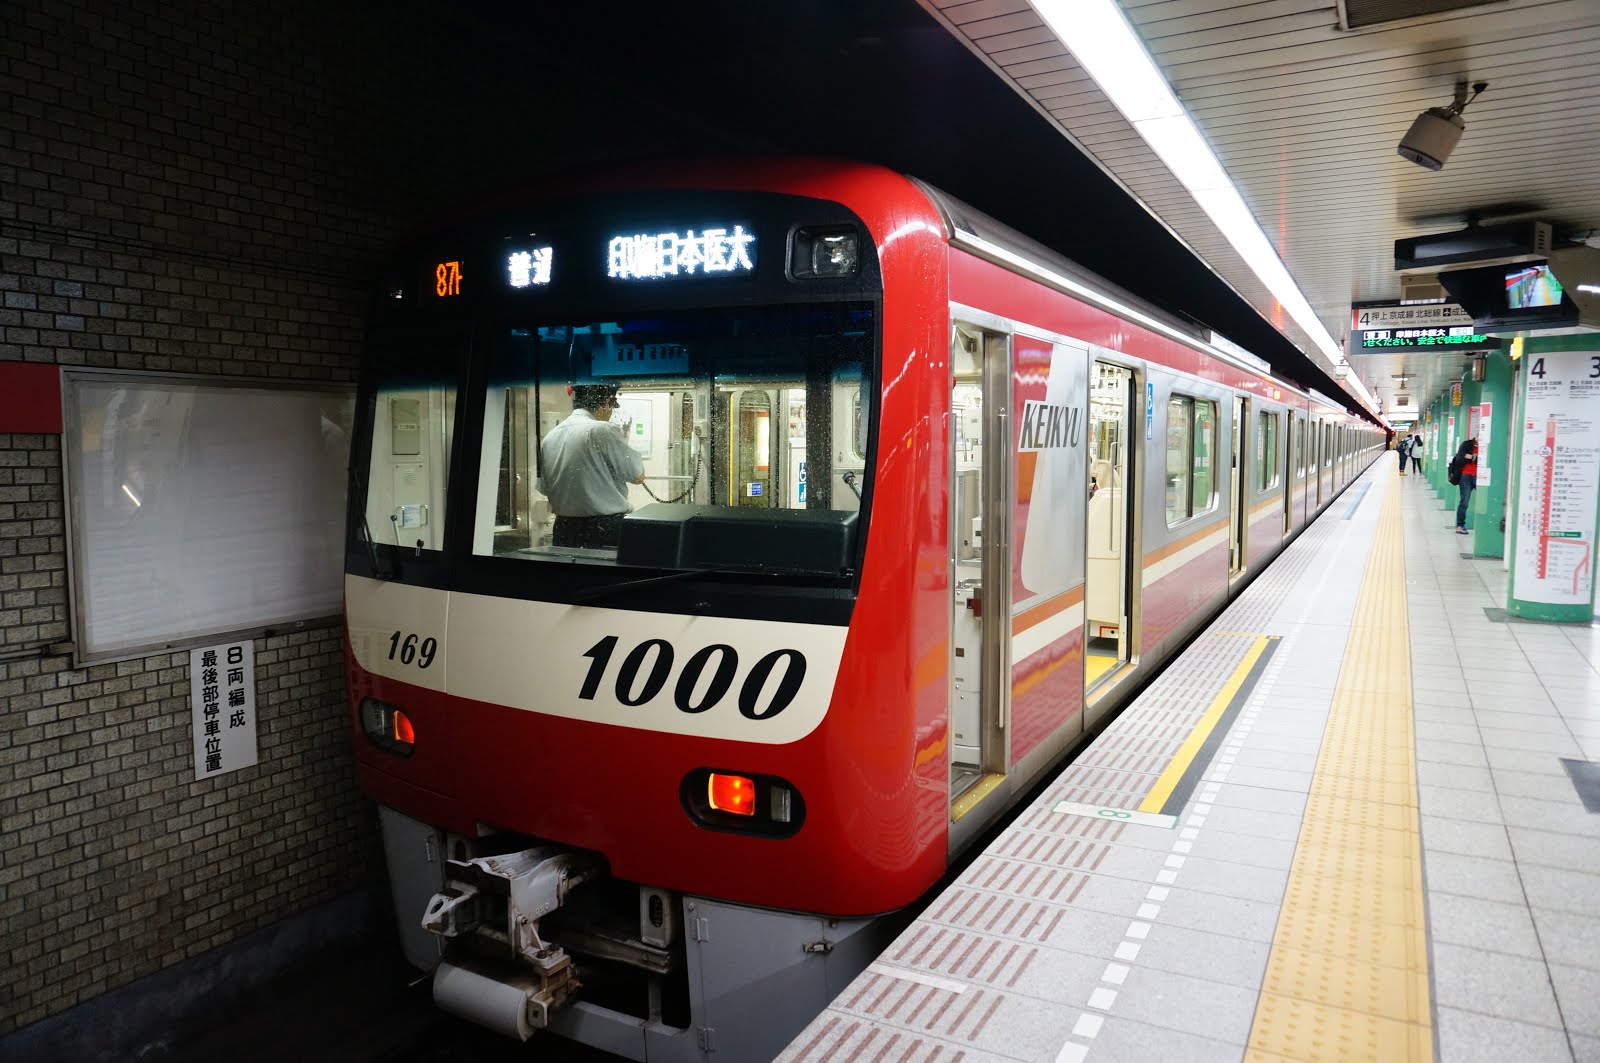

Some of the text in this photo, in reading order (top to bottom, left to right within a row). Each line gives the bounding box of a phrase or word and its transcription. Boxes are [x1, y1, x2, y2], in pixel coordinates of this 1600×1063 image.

[1359, 312, 1371, 326] 4
[1371, 311, 1388, 321] 押上
[1389, 310, 1415, 320] 京成線
[1416, 308, 1442, 318] 北総線
[1530, 357, 1547, 379] 4
[1589, 356, 1600, 379] 3
[1020, 402, 1084, 449] KEIKYU
[388, 631, 437, 669] 169
[227, 645, 246, 729] 8両編成
[578, 635, 808, 721] 1000
[201, 649, 222, 773] 最後部停車位置
